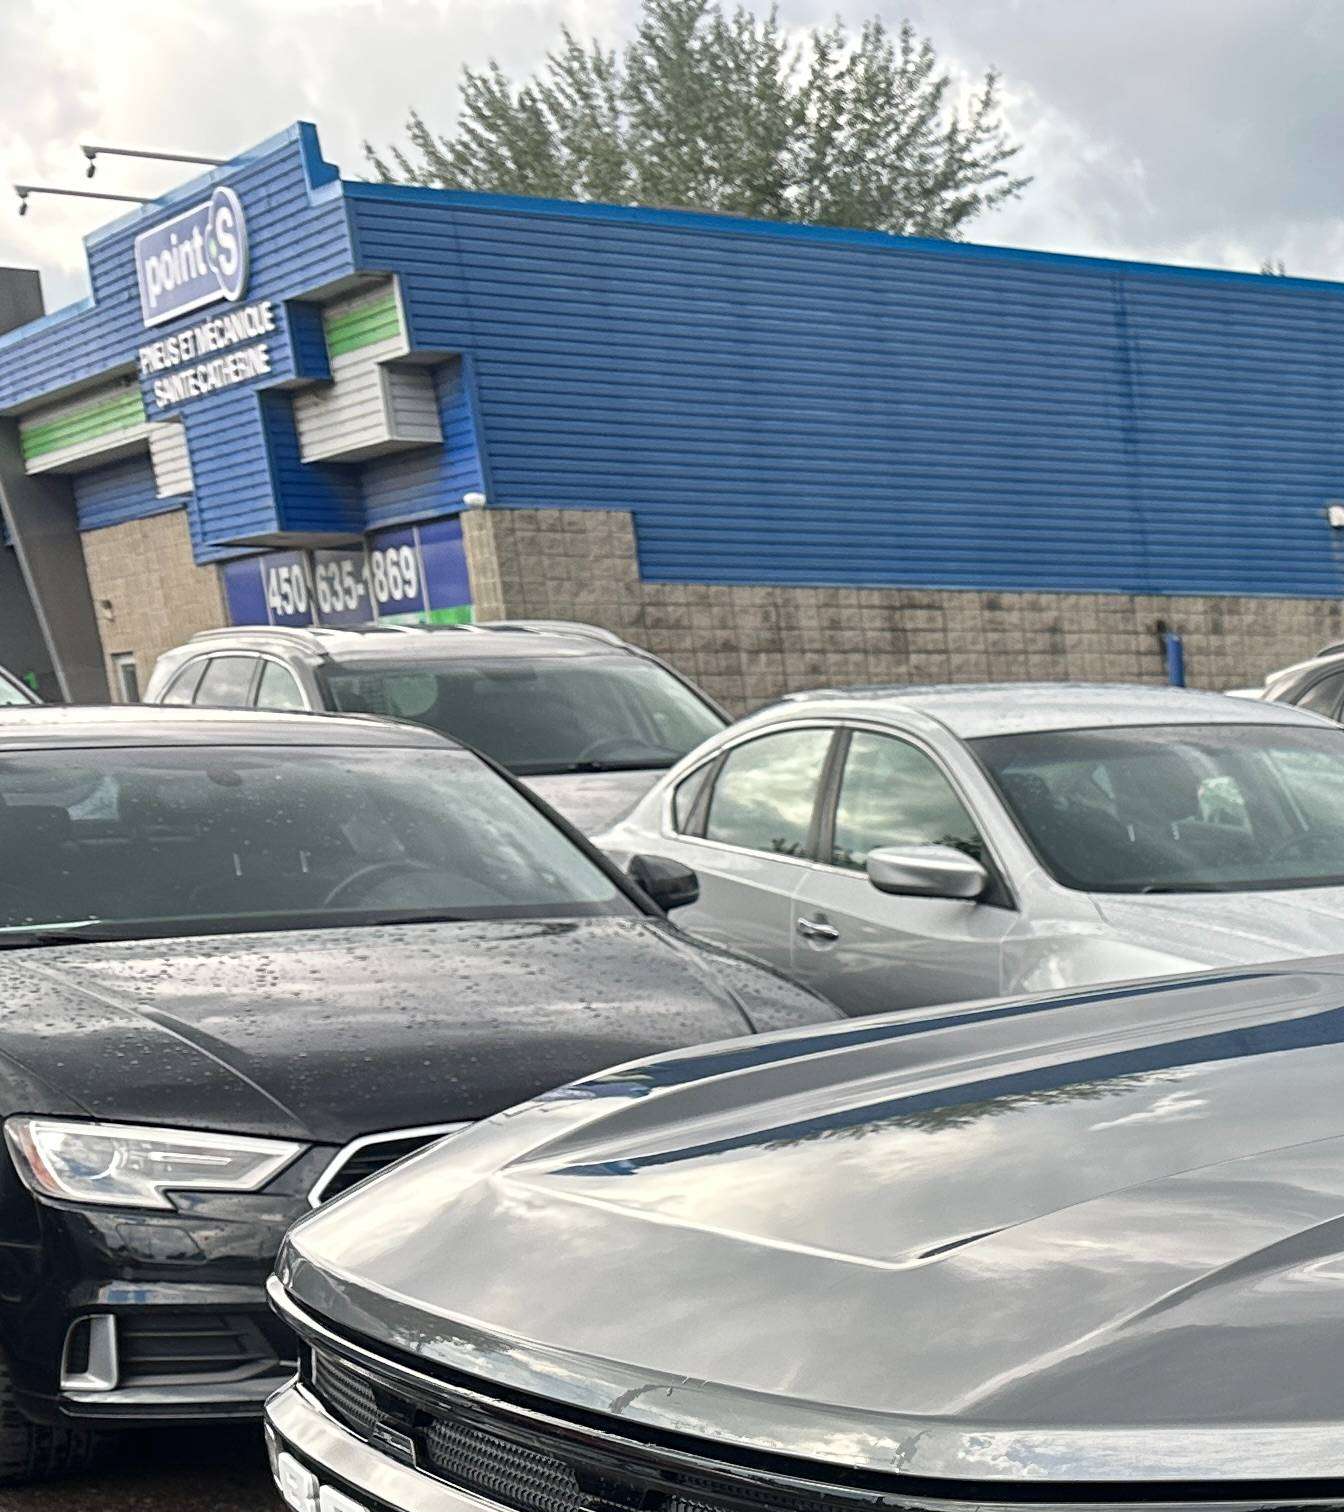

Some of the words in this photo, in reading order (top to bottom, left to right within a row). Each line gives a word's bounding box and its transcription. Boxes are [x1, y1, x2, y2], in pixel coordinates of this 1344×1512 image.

[145, 225, 207, 308] point
[215, 206, 238, 276] S
[269, 564, 307, 615] 450
